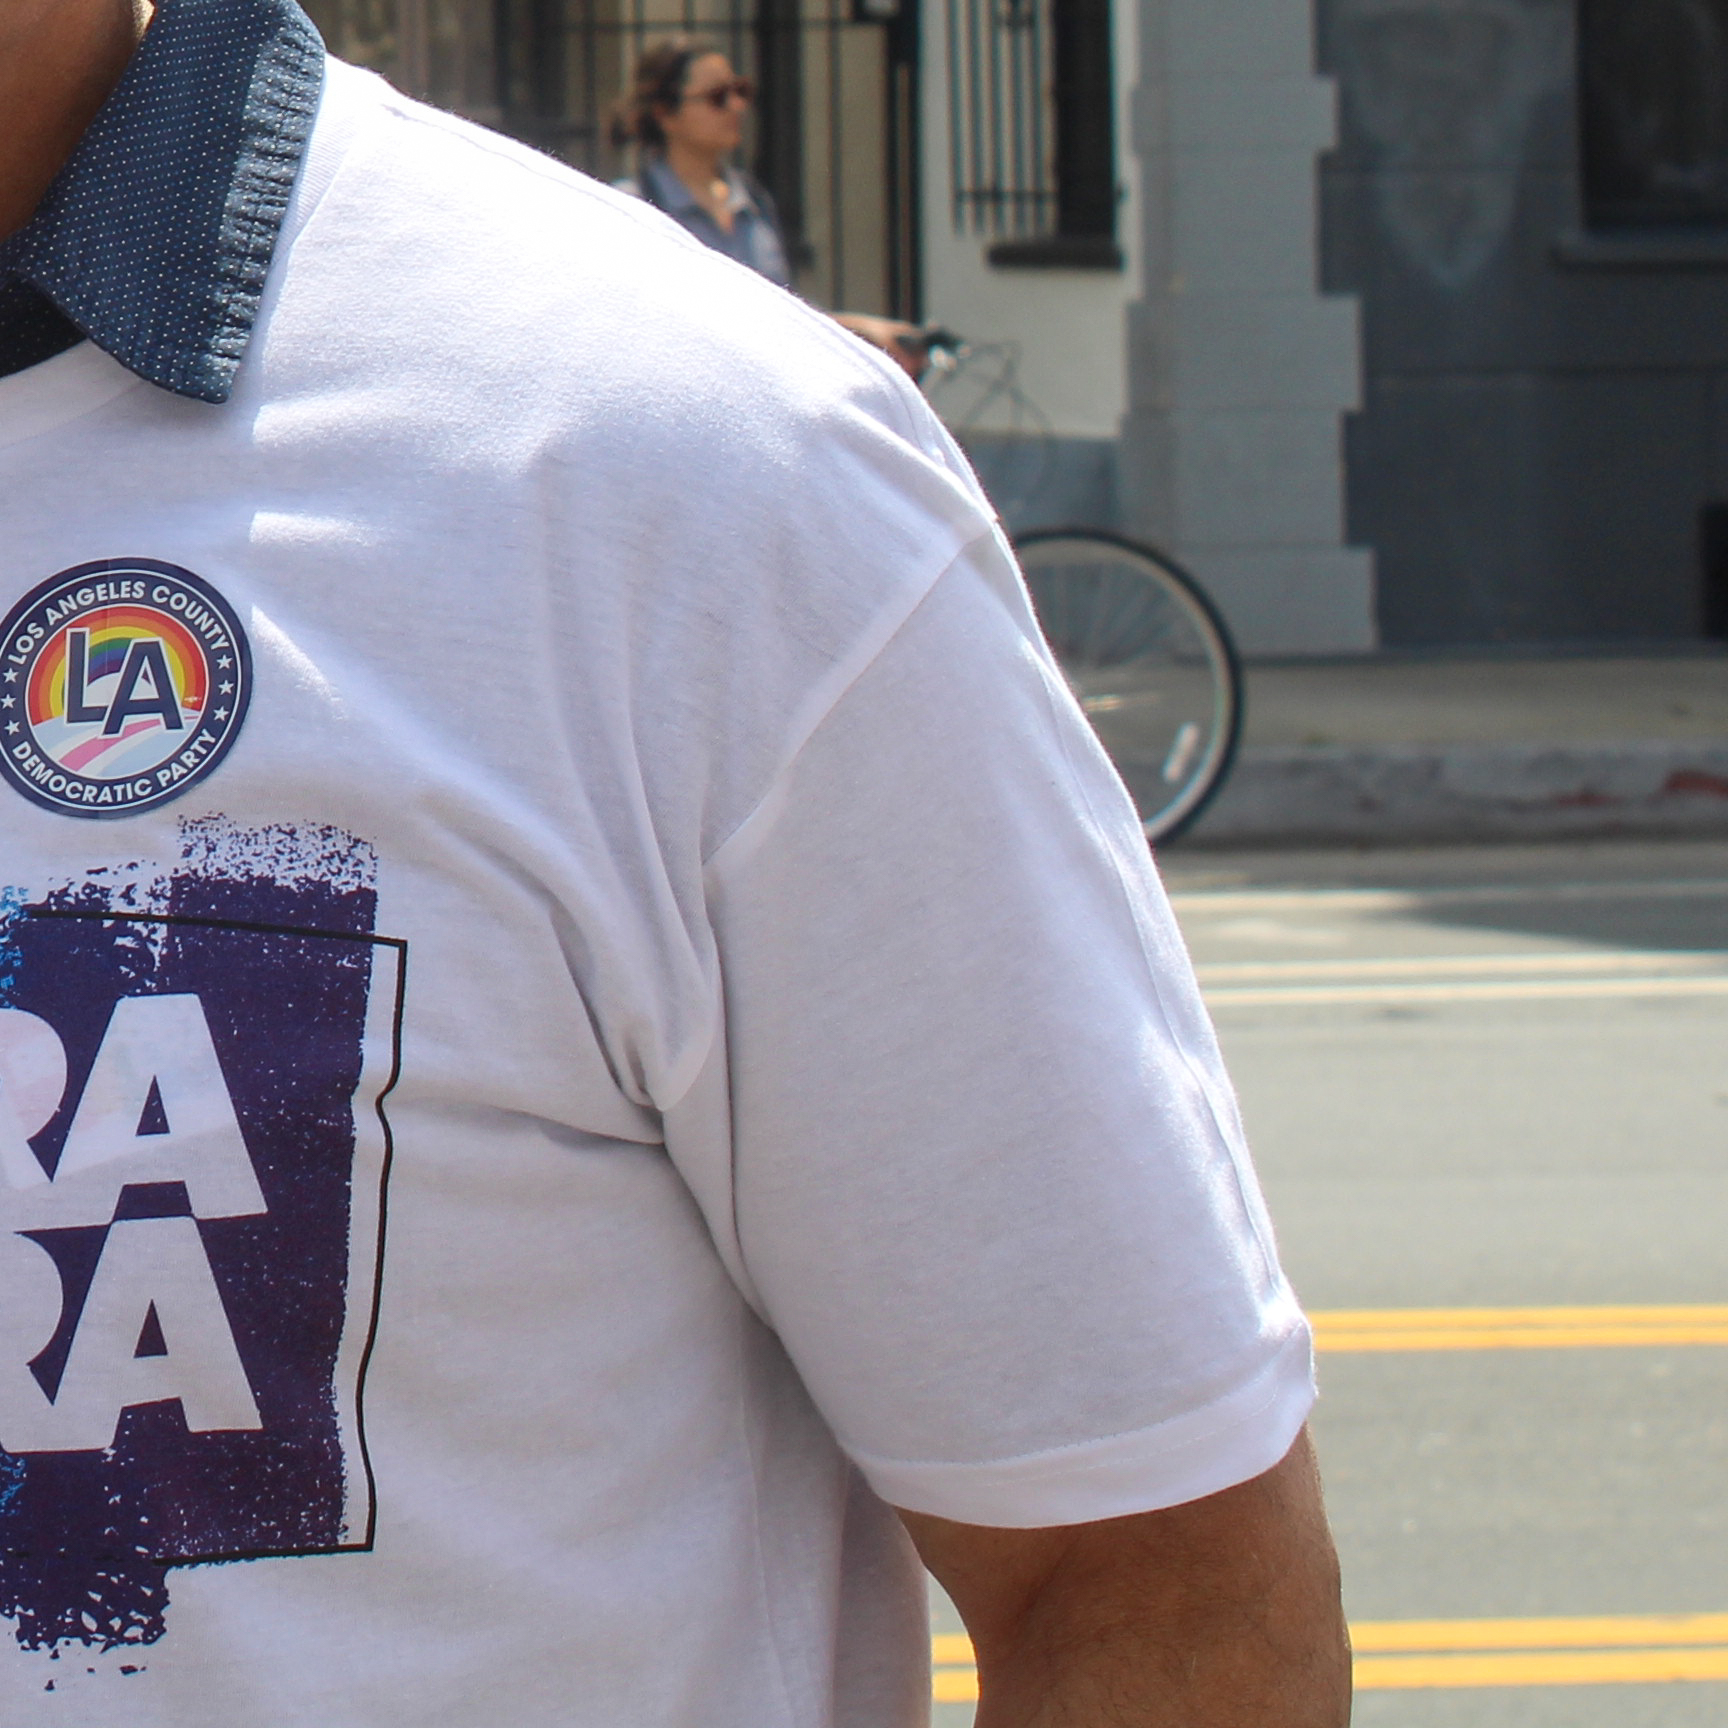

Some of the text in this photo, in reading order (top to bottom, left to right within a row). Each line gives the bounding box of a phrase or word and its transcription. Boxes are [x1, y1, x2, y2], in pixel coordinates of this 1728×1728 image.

[7, 579, 231, 666] LOS ANGELES COUNTY
[63, 626, 187, 740] LA
[12, 727, 218, 805] DEMOCRATIC PARTY
